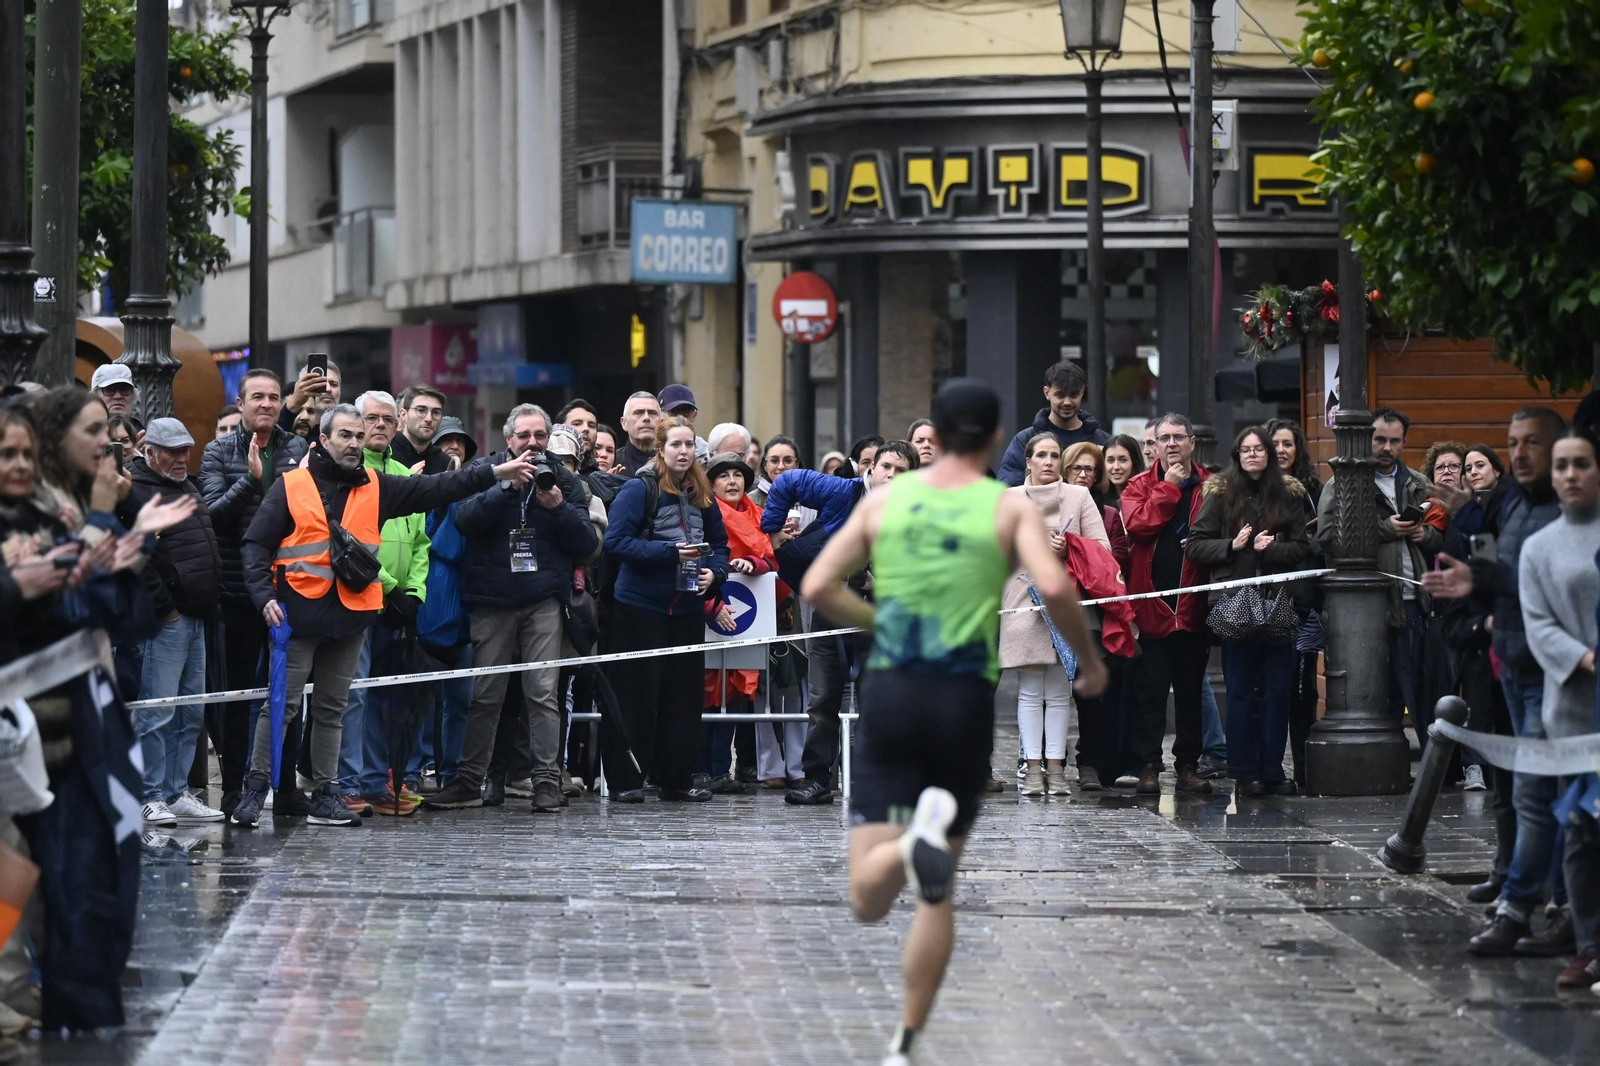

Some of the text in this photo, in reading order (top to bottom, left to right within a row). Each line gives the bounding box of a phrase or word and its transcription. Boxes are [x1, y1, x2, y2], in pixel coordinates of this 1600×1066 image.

[808, 149, 1142, 216] DAVID
[664, 209, 705, 229] BAR
[640, 234, 729, 275] CORREO
